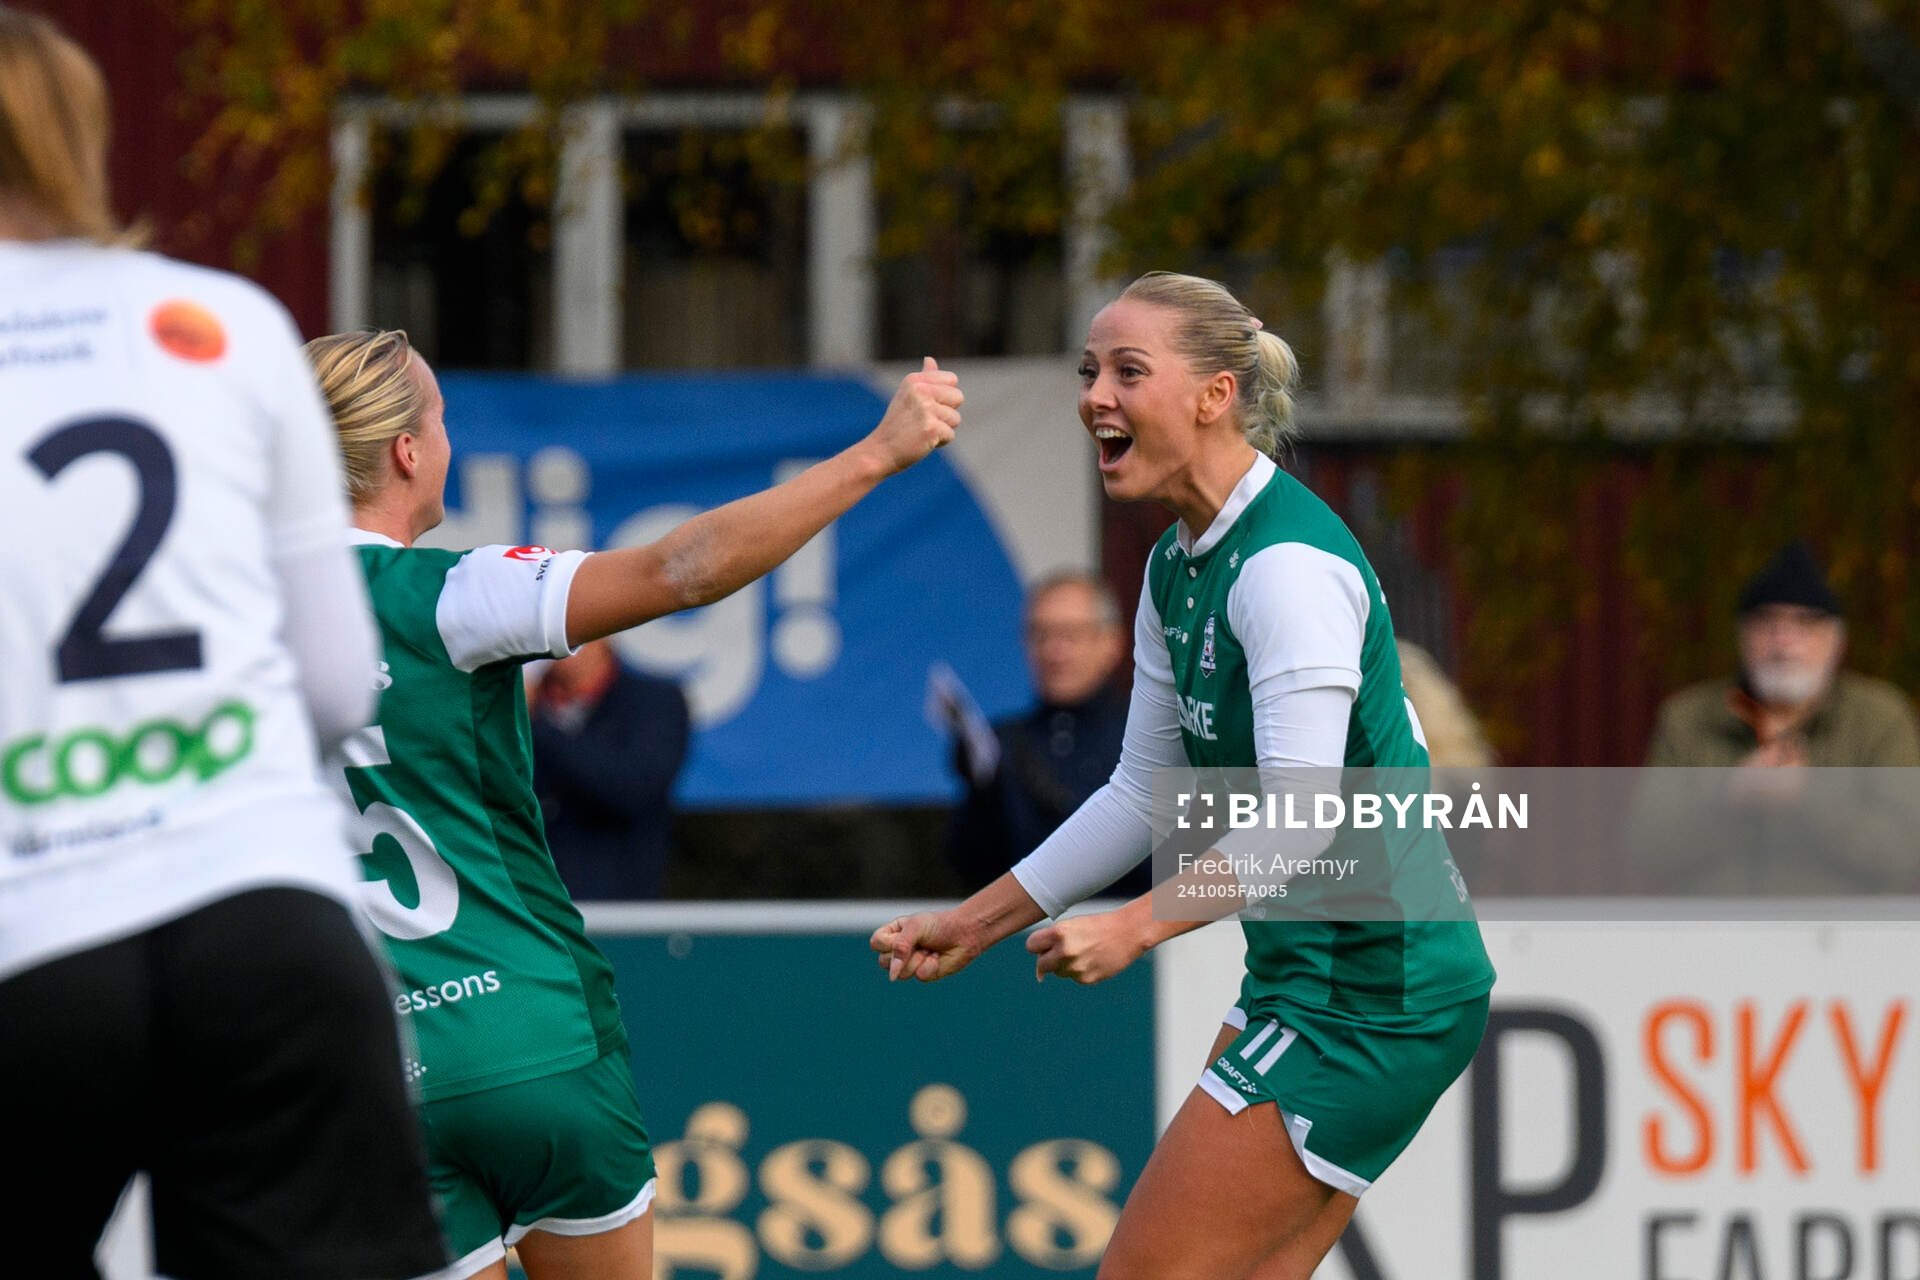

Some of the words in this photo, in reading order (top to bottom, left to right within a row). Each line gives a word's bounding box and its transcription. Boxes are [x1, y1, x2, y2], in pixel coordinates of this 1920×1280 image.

[25, 413, 204, 684] 2
[1, 698, 257, 806] coop
[1217, 1056, 1249, 1088] CRAFT
[1239, 1018, 1299, 1077] 11
[1643, 1000, 1907, 1176] SKY
